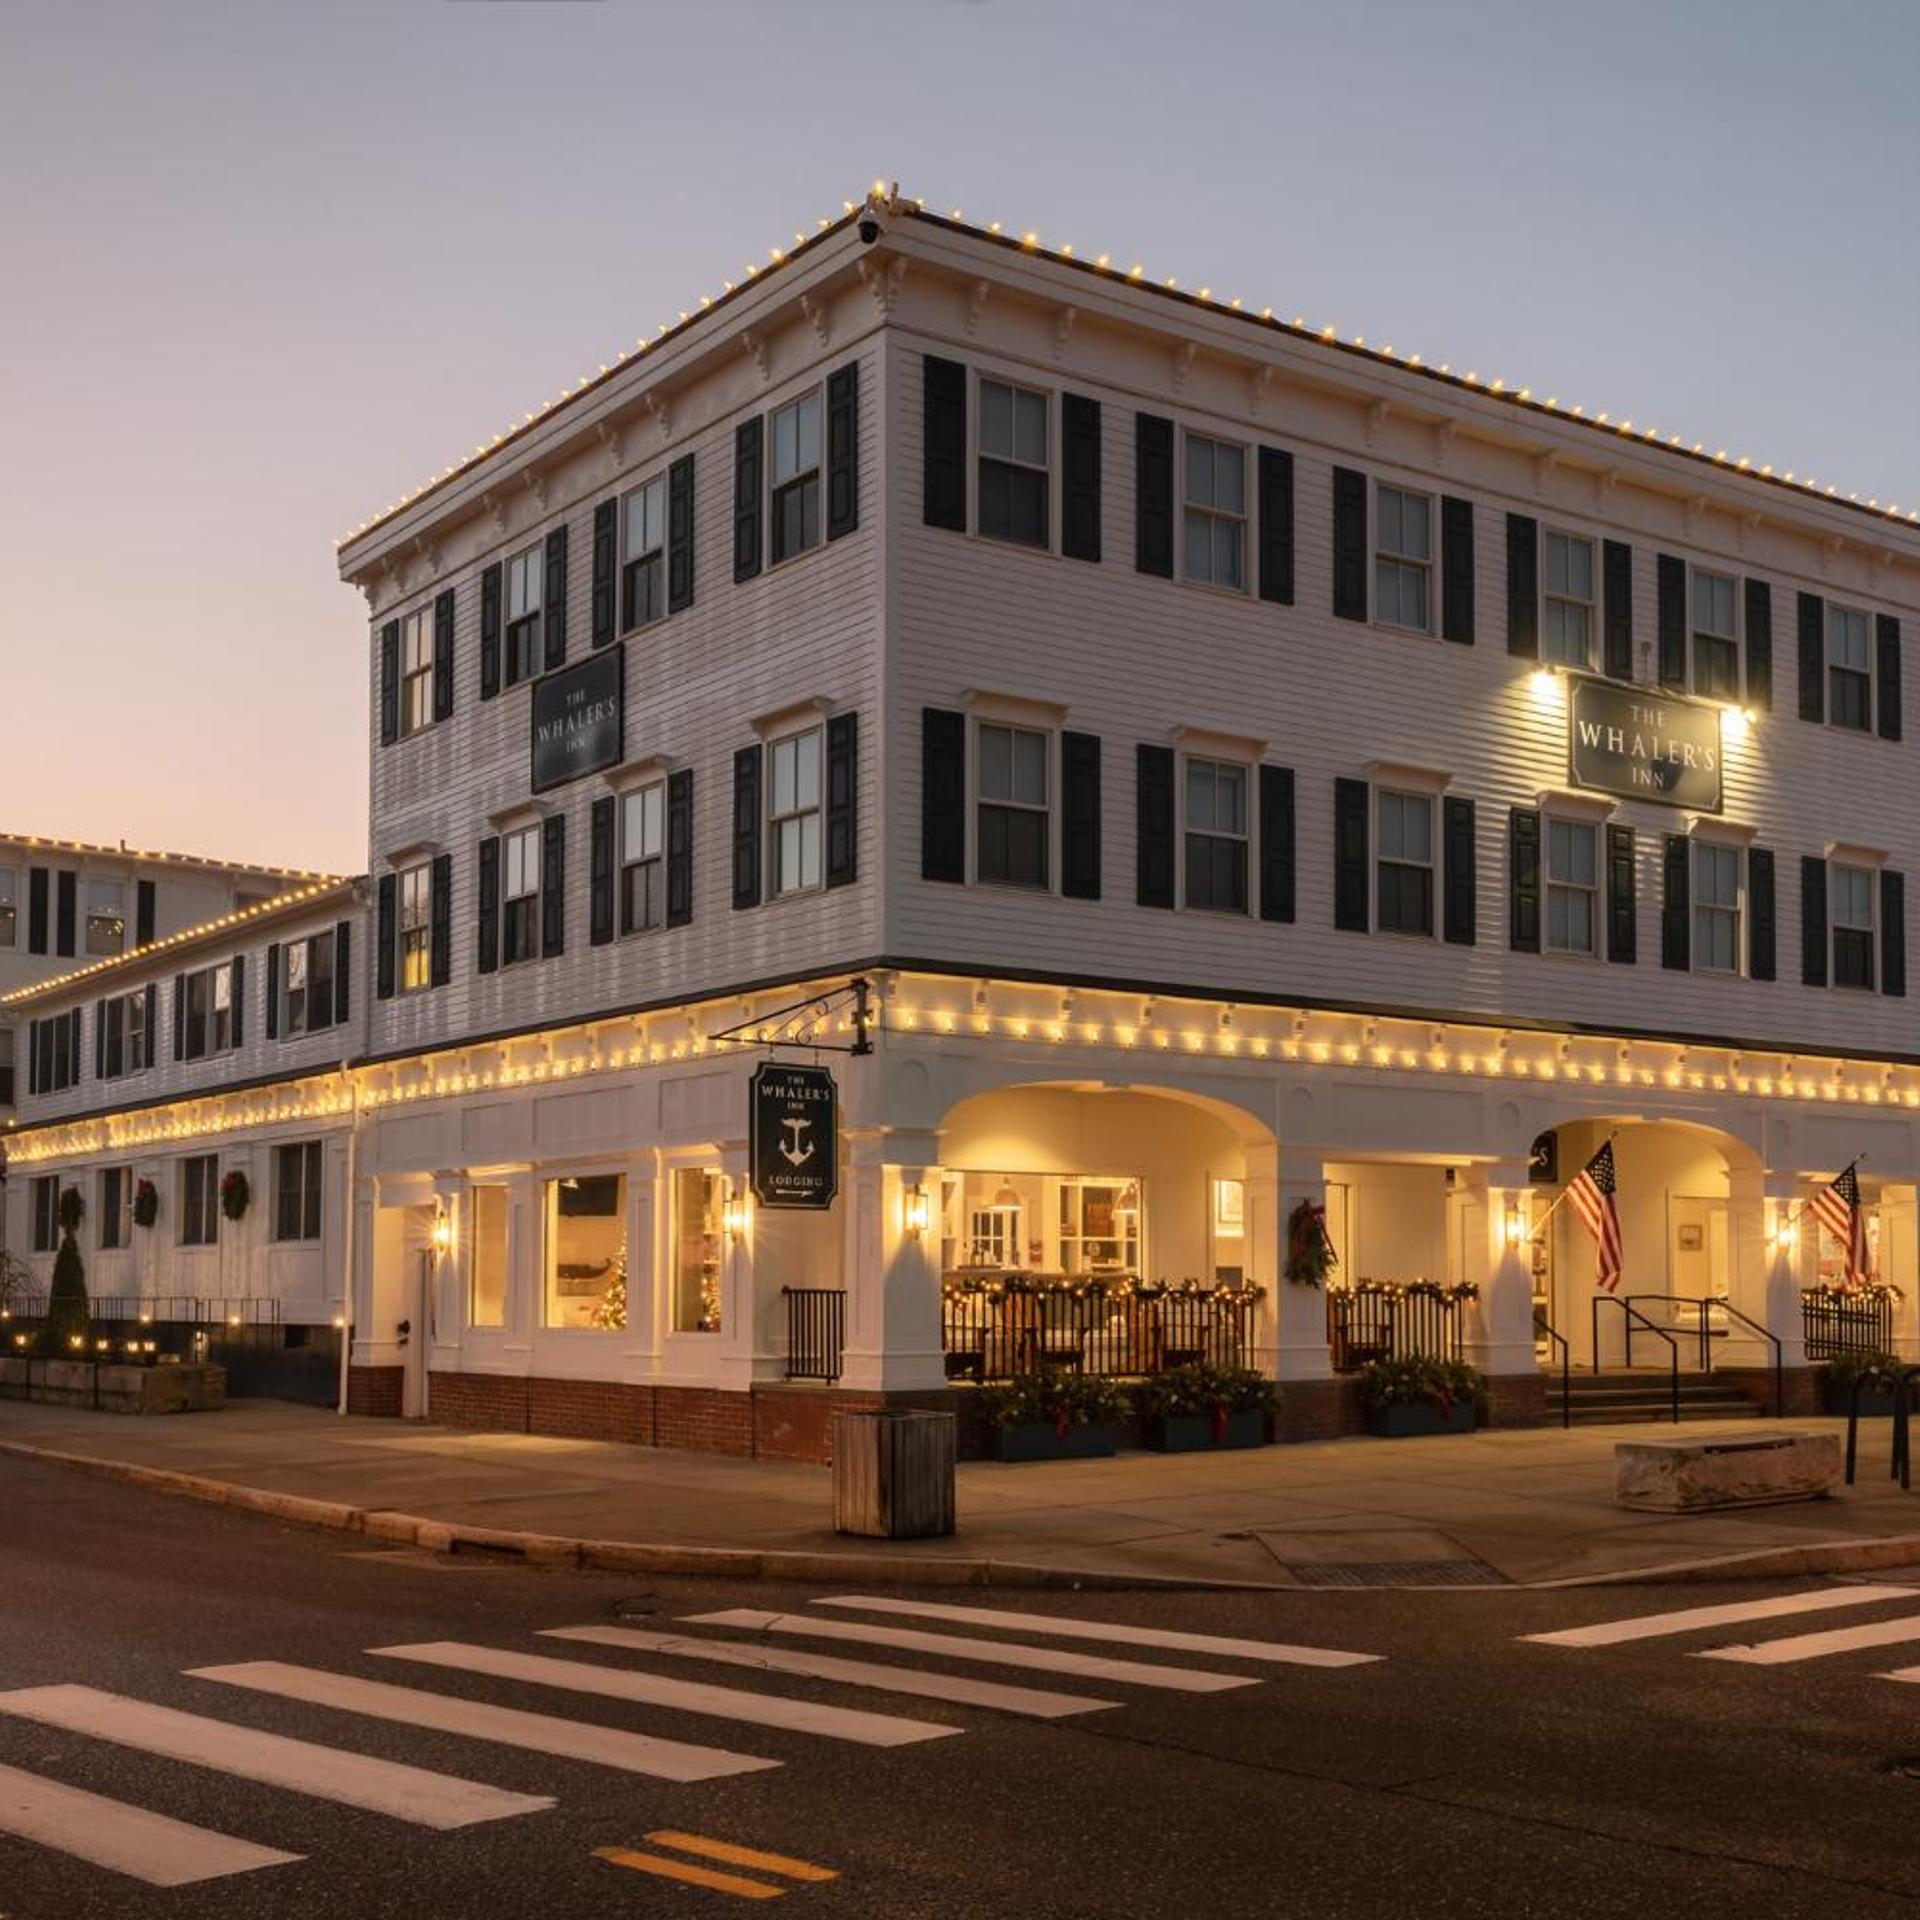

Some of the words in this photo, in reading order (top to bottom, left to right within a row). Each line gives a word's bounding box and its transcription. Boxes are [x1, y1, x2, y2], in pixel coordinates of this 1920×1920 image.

[1629, 704, 1667, 728] THE
[1578, 720, 1715, 771] WHALER'S
[1632, 766, 1664, 788] INN
[762, 1084, 830, 1101] WHALER'S
[769, 1174, 824, 1187] LODGING
